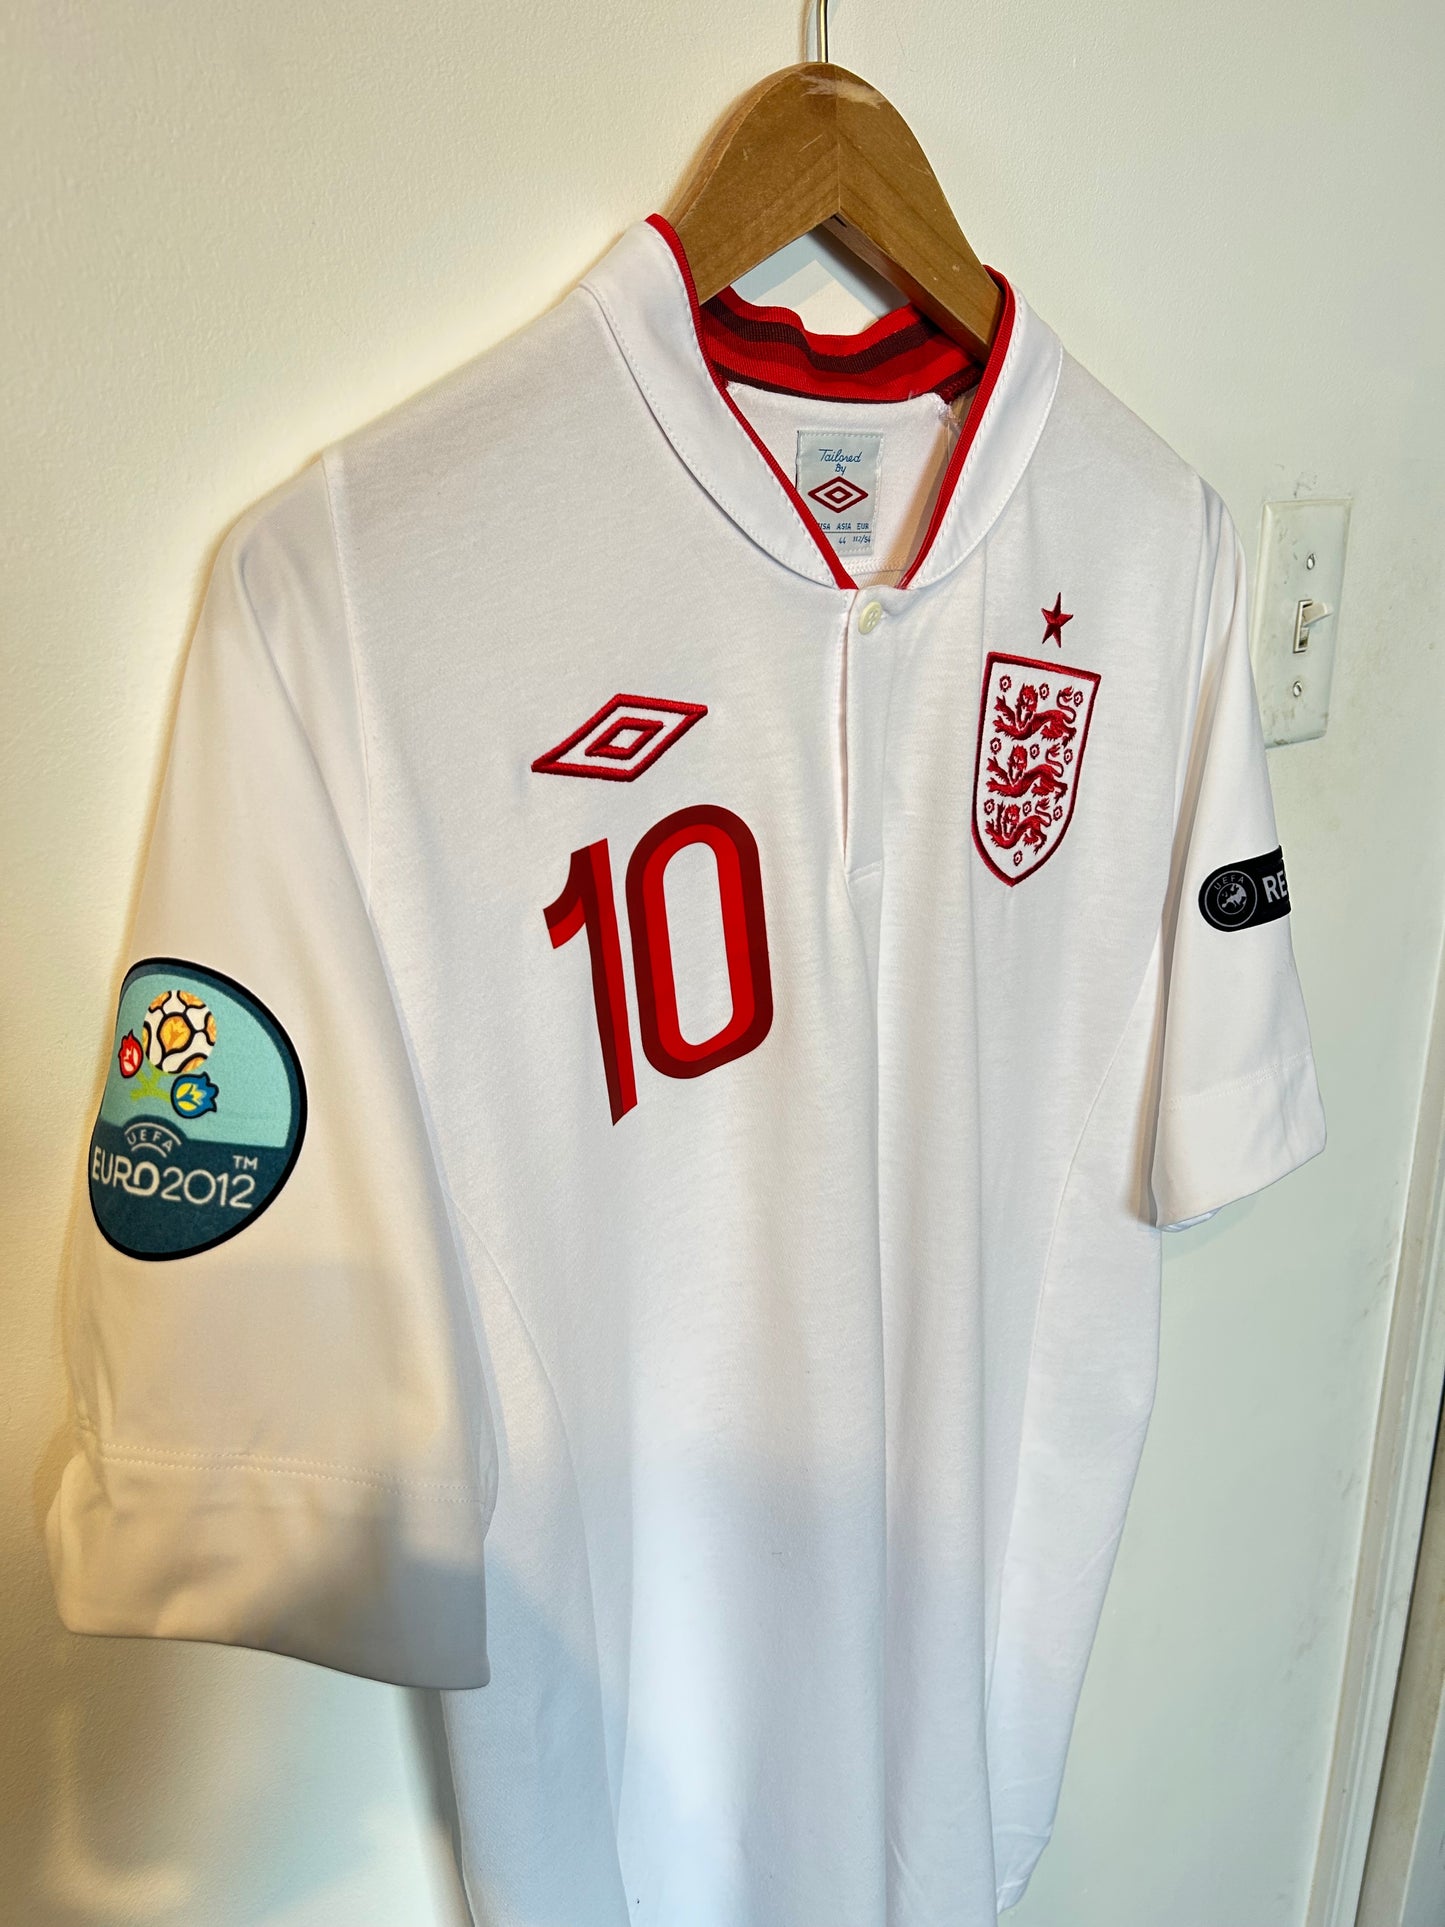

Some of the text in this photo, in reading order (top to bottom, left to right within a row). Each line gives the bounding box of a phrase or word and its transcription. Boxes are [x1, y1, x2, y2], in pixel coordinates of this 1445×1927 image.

[818, 448, 862, 463] Tailored
[835, 463, 847, 476] By
[836, 522, 852, 530] ASIA
[856, 522, 870, 530] EUR
[1213, 874, 1245, 891] UEFA
[543, 804, 774, 1126] 10
[127, 1129, 173, 1152] UEFA
[232, 1155, 259, 1171] TM
